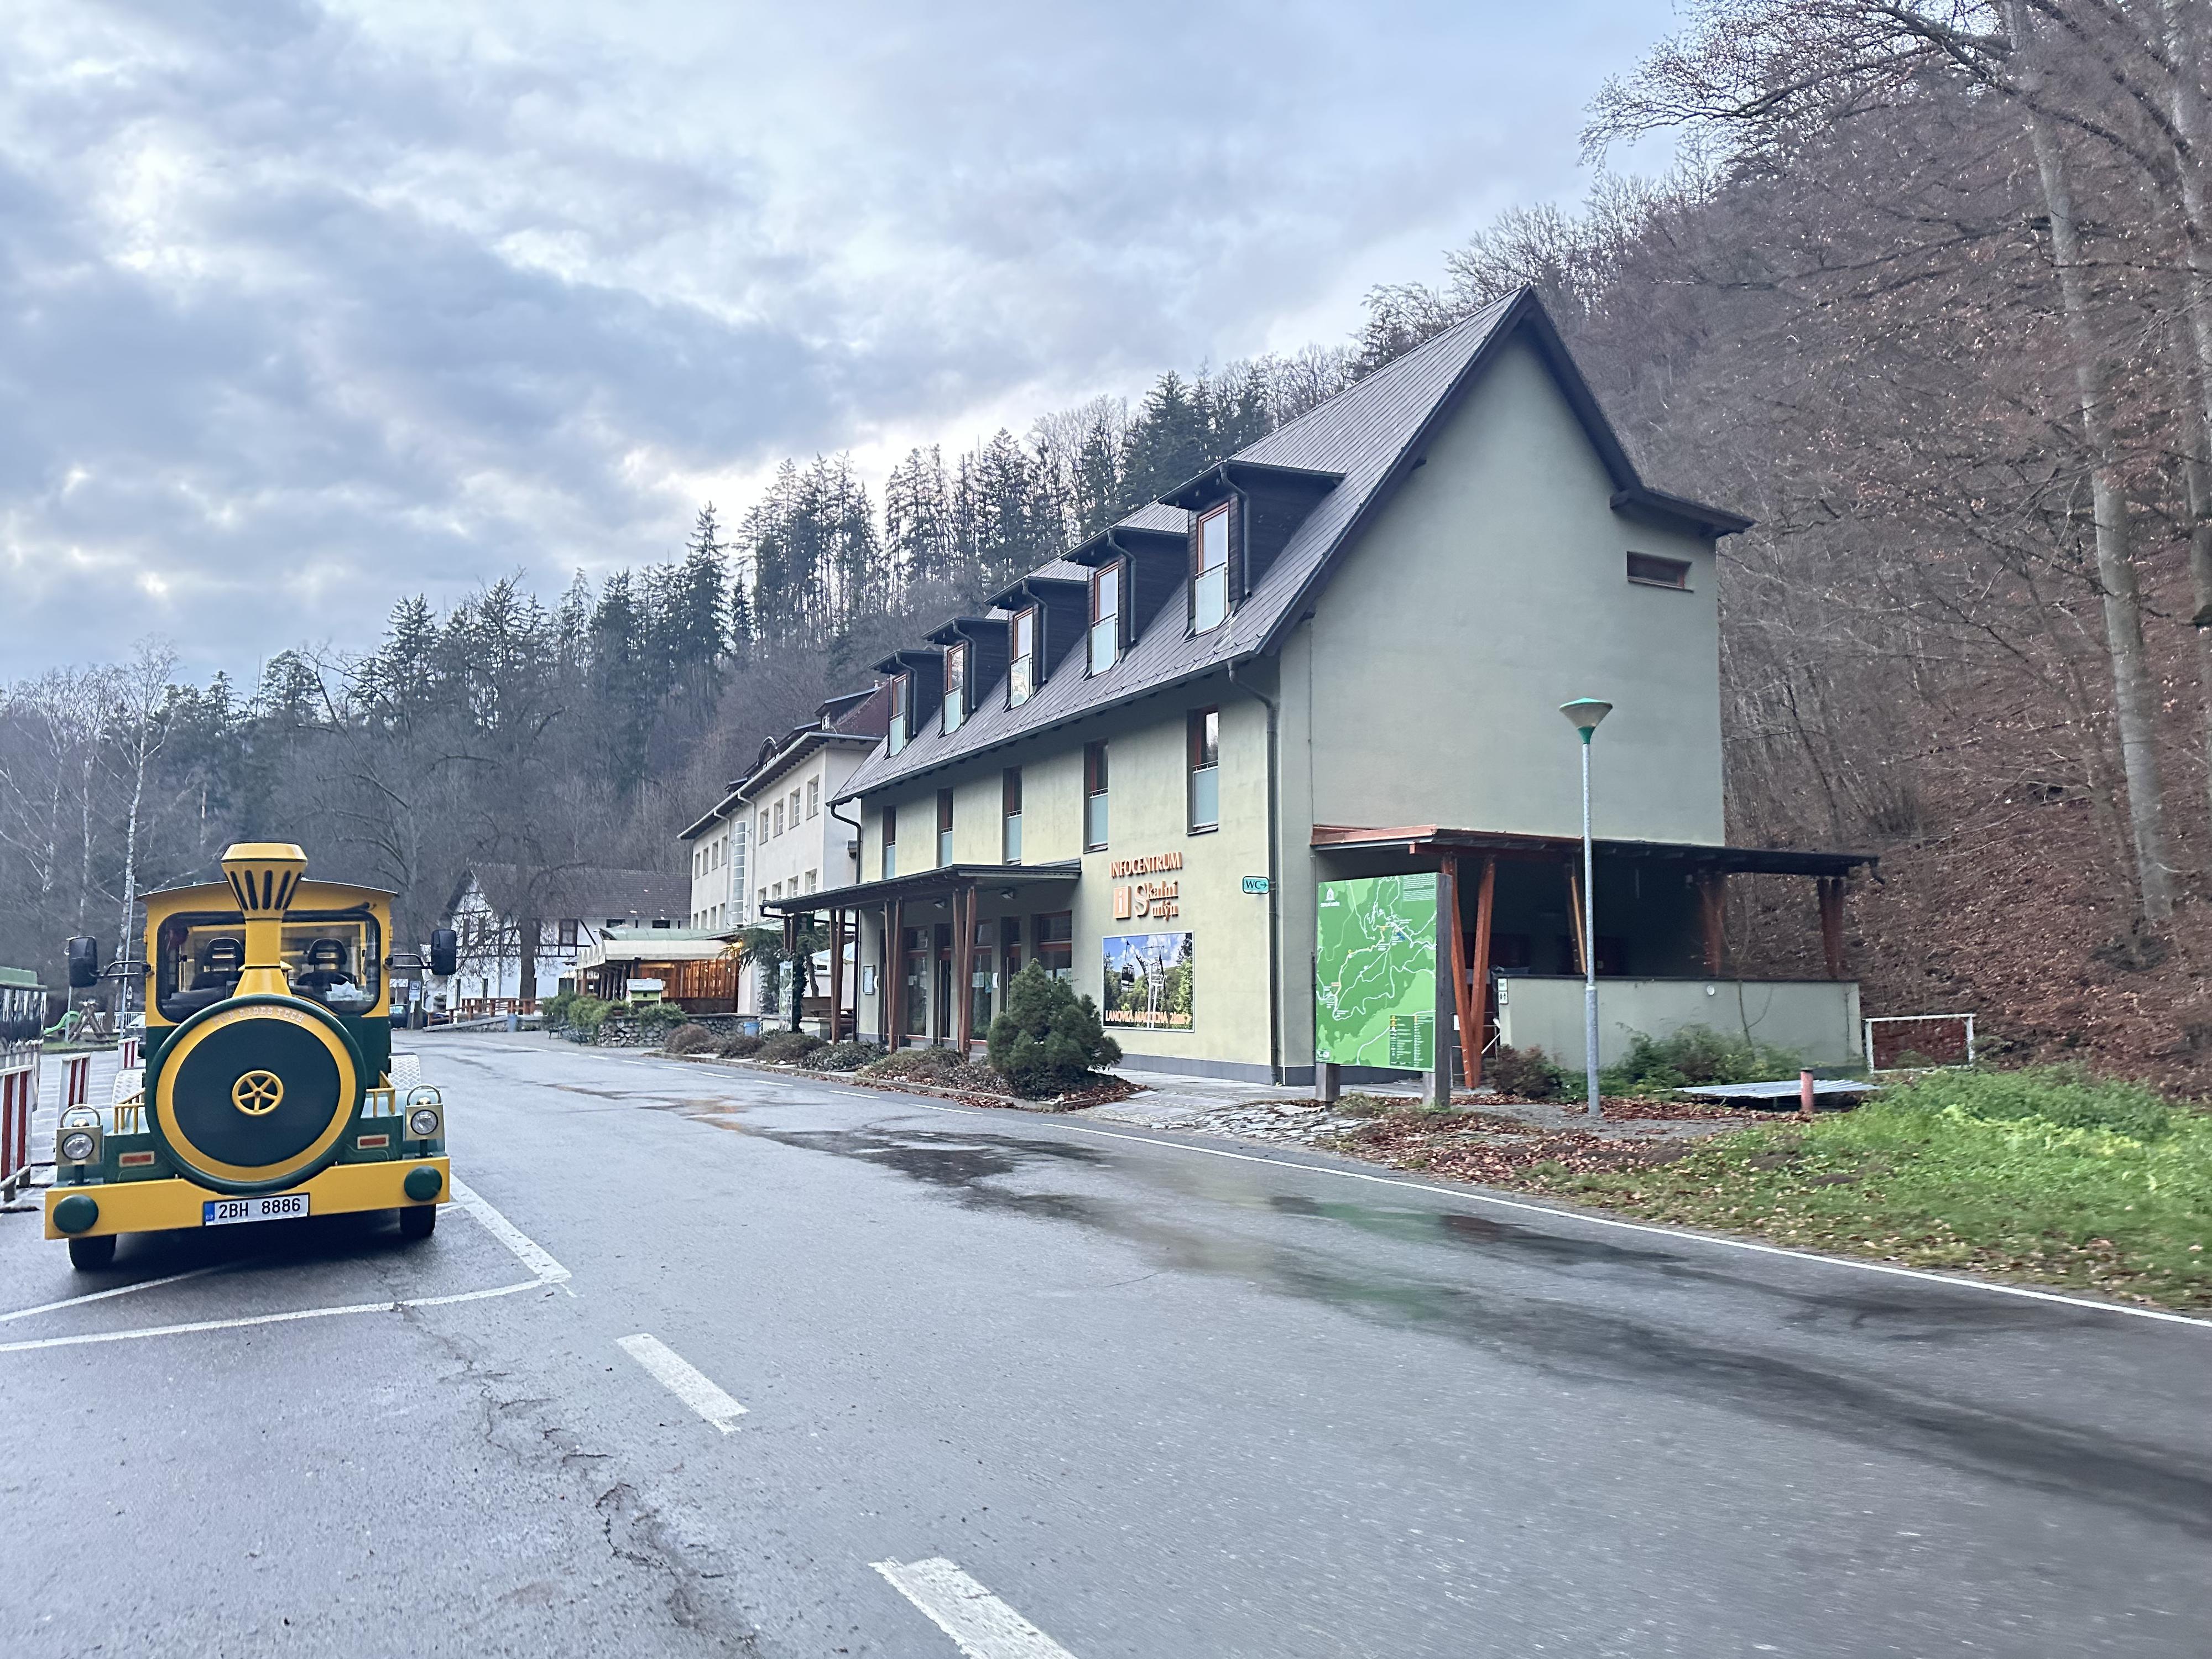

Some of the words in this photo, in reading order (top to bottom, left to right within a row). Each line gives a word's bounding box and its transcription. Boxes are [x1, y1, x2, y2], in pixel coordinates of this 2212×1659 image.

[1109, 852, 1182, 878] INFOCENTRUM
[1246, 880, 1261, 889] WC
[1134, 880, 1178, 917] Skalní
[1152, 900, 1178, 921] mlýn
[239, 1006, 274, 1017] RIDES
[277, 1008, 304, 1022] TECH
[219, 1202, 248, 1219] 2BH
[262, 1198, 300, 1214] 8886
